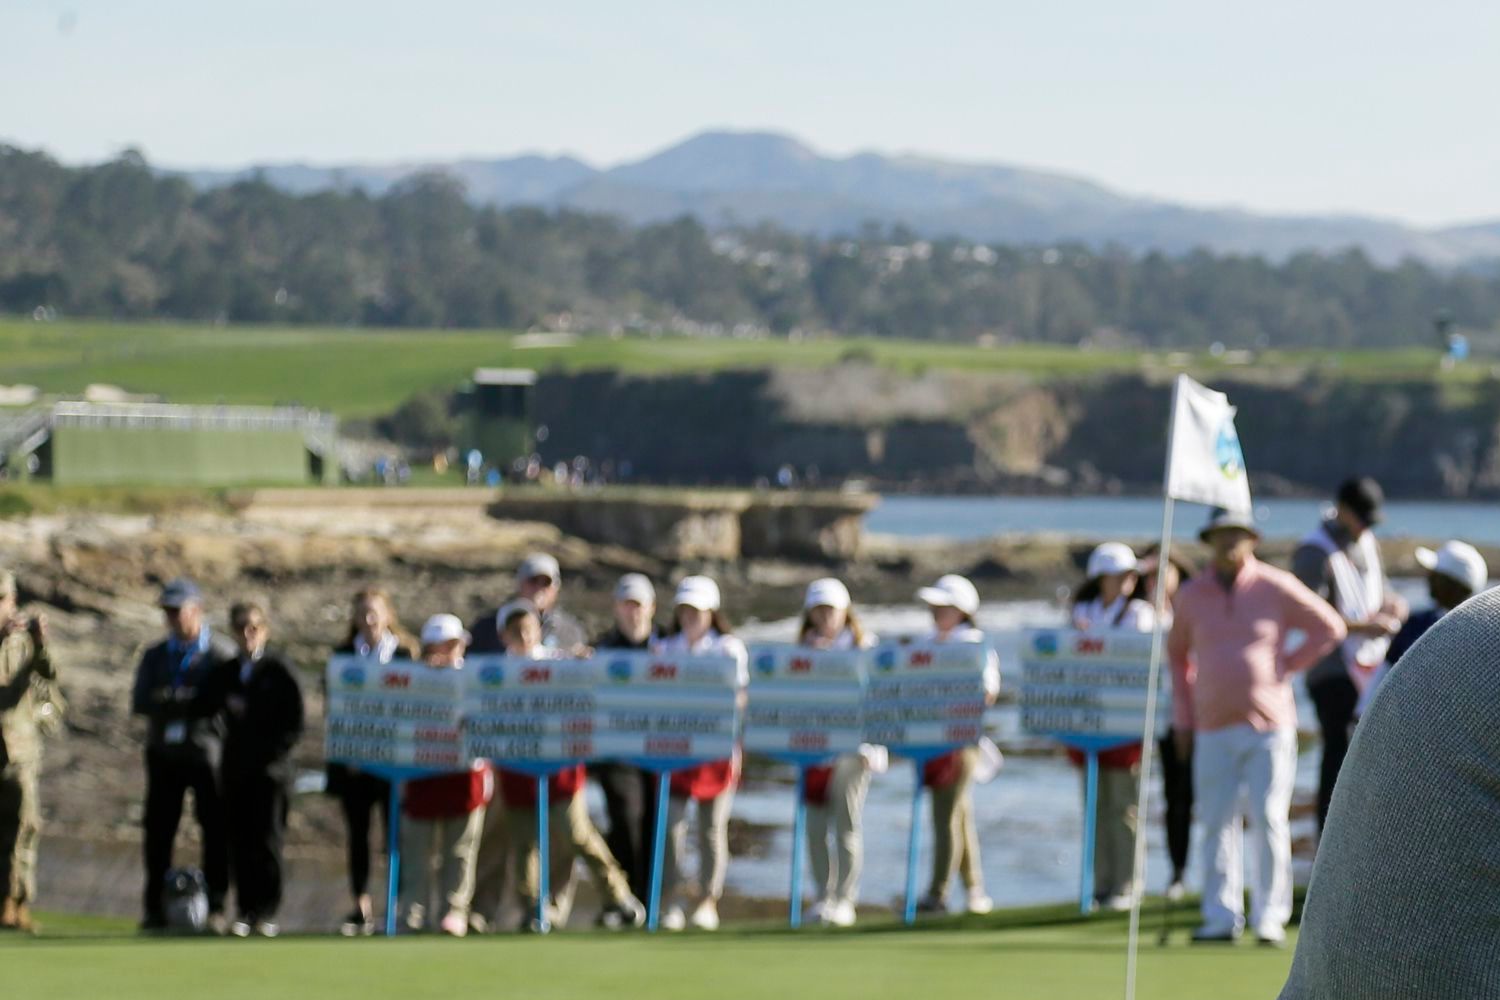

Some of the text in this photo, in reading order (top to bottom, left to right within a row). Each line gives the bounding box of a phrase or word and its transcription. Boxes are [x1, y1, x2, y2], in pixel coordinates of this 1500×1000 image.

[1077, 638, 1104, 653] 3M
[788, 656, 812, 673] 3M
[908, 648, 935, 665] 3M
[521, 667, 549, 682] 3M
[648, 663, 678, 680] 3M
[383, 672, 411, 688] 3M
